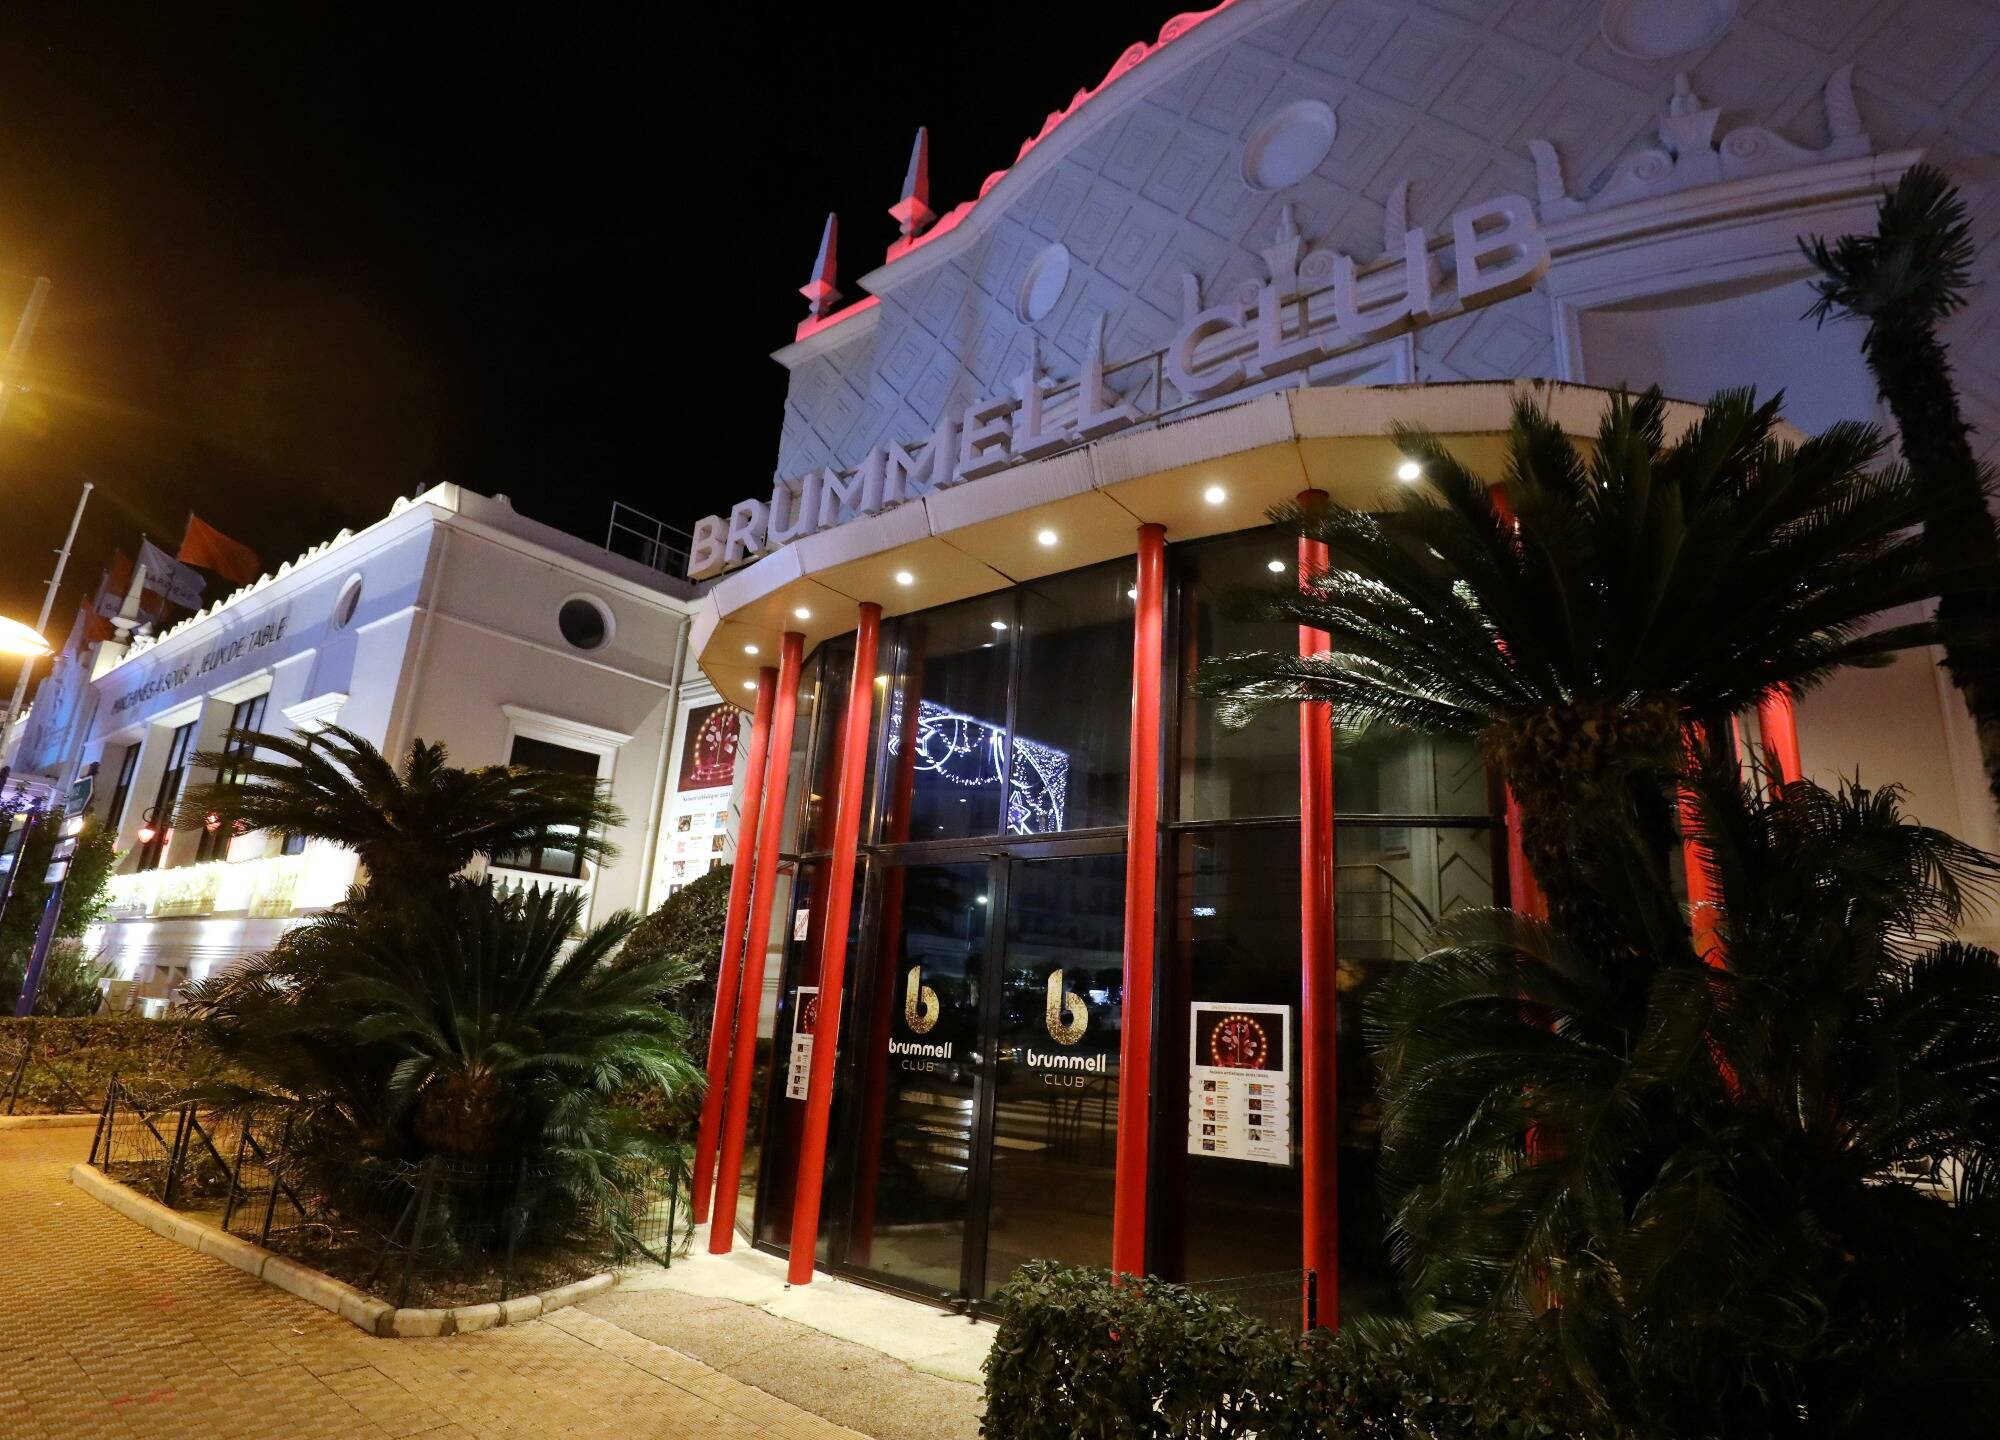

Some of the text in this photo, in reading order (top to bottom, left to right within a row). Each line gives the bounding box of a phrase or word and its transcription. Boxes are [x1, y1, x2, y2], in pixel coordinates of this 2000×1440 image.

[687, 194, 1551, 579] BRUMMELL CLUB
[248, 616, 288, 651] TABLE
[888, 1037, 952, 1059] brummell
[901, 1059, 934, 1072] CLUB
[1027, 1048, 1106, 1073] brummell
[1044, 1073, 1085, 1088] CLUB
